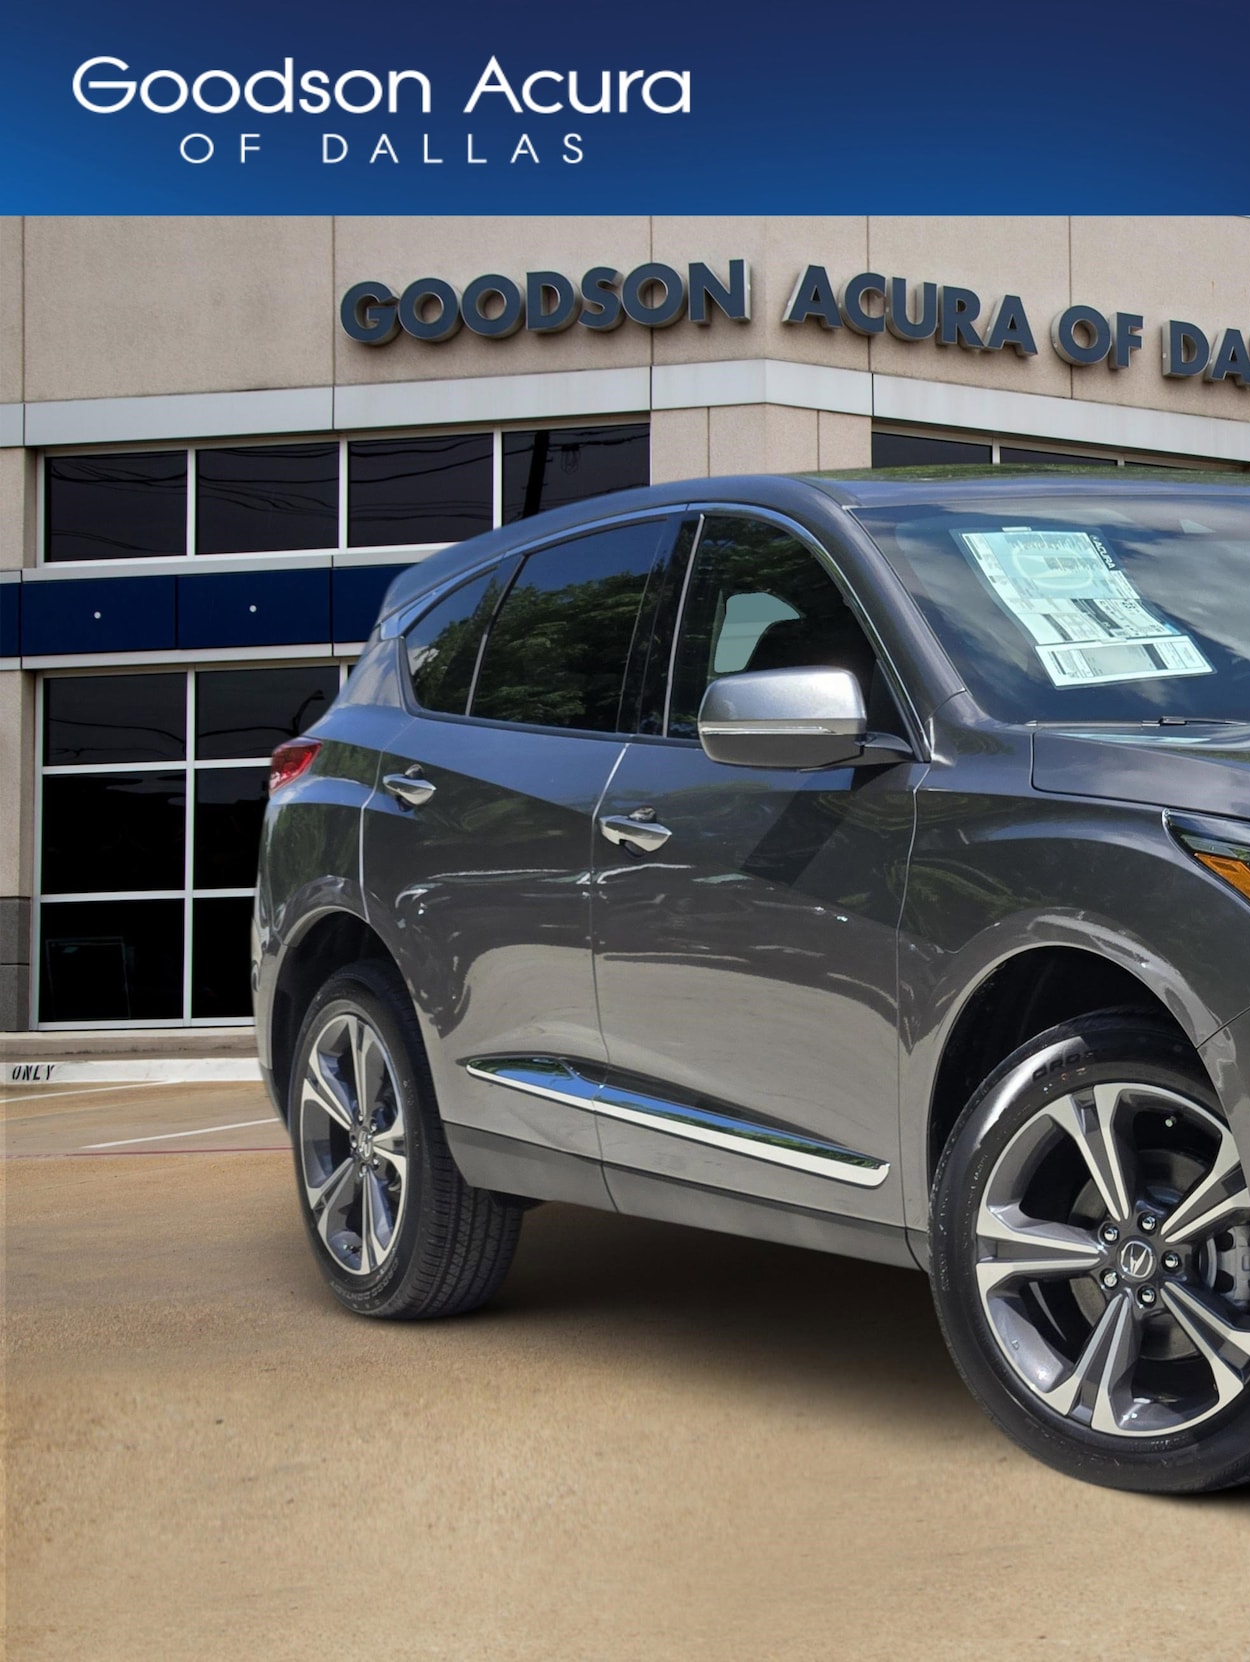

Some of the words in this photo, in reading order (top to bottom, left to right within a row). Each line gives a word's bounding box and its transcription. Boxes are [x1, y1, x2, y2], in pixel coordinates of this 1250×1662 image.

[340, 259, 750, 345] GOODSON
[782, 265, 1039, 357] ACURA
[1051, 304, 1144, 369] OF
[1093, 541, 1116, 569] ACURA
[12, 1064, 55, 1081] ONLY
